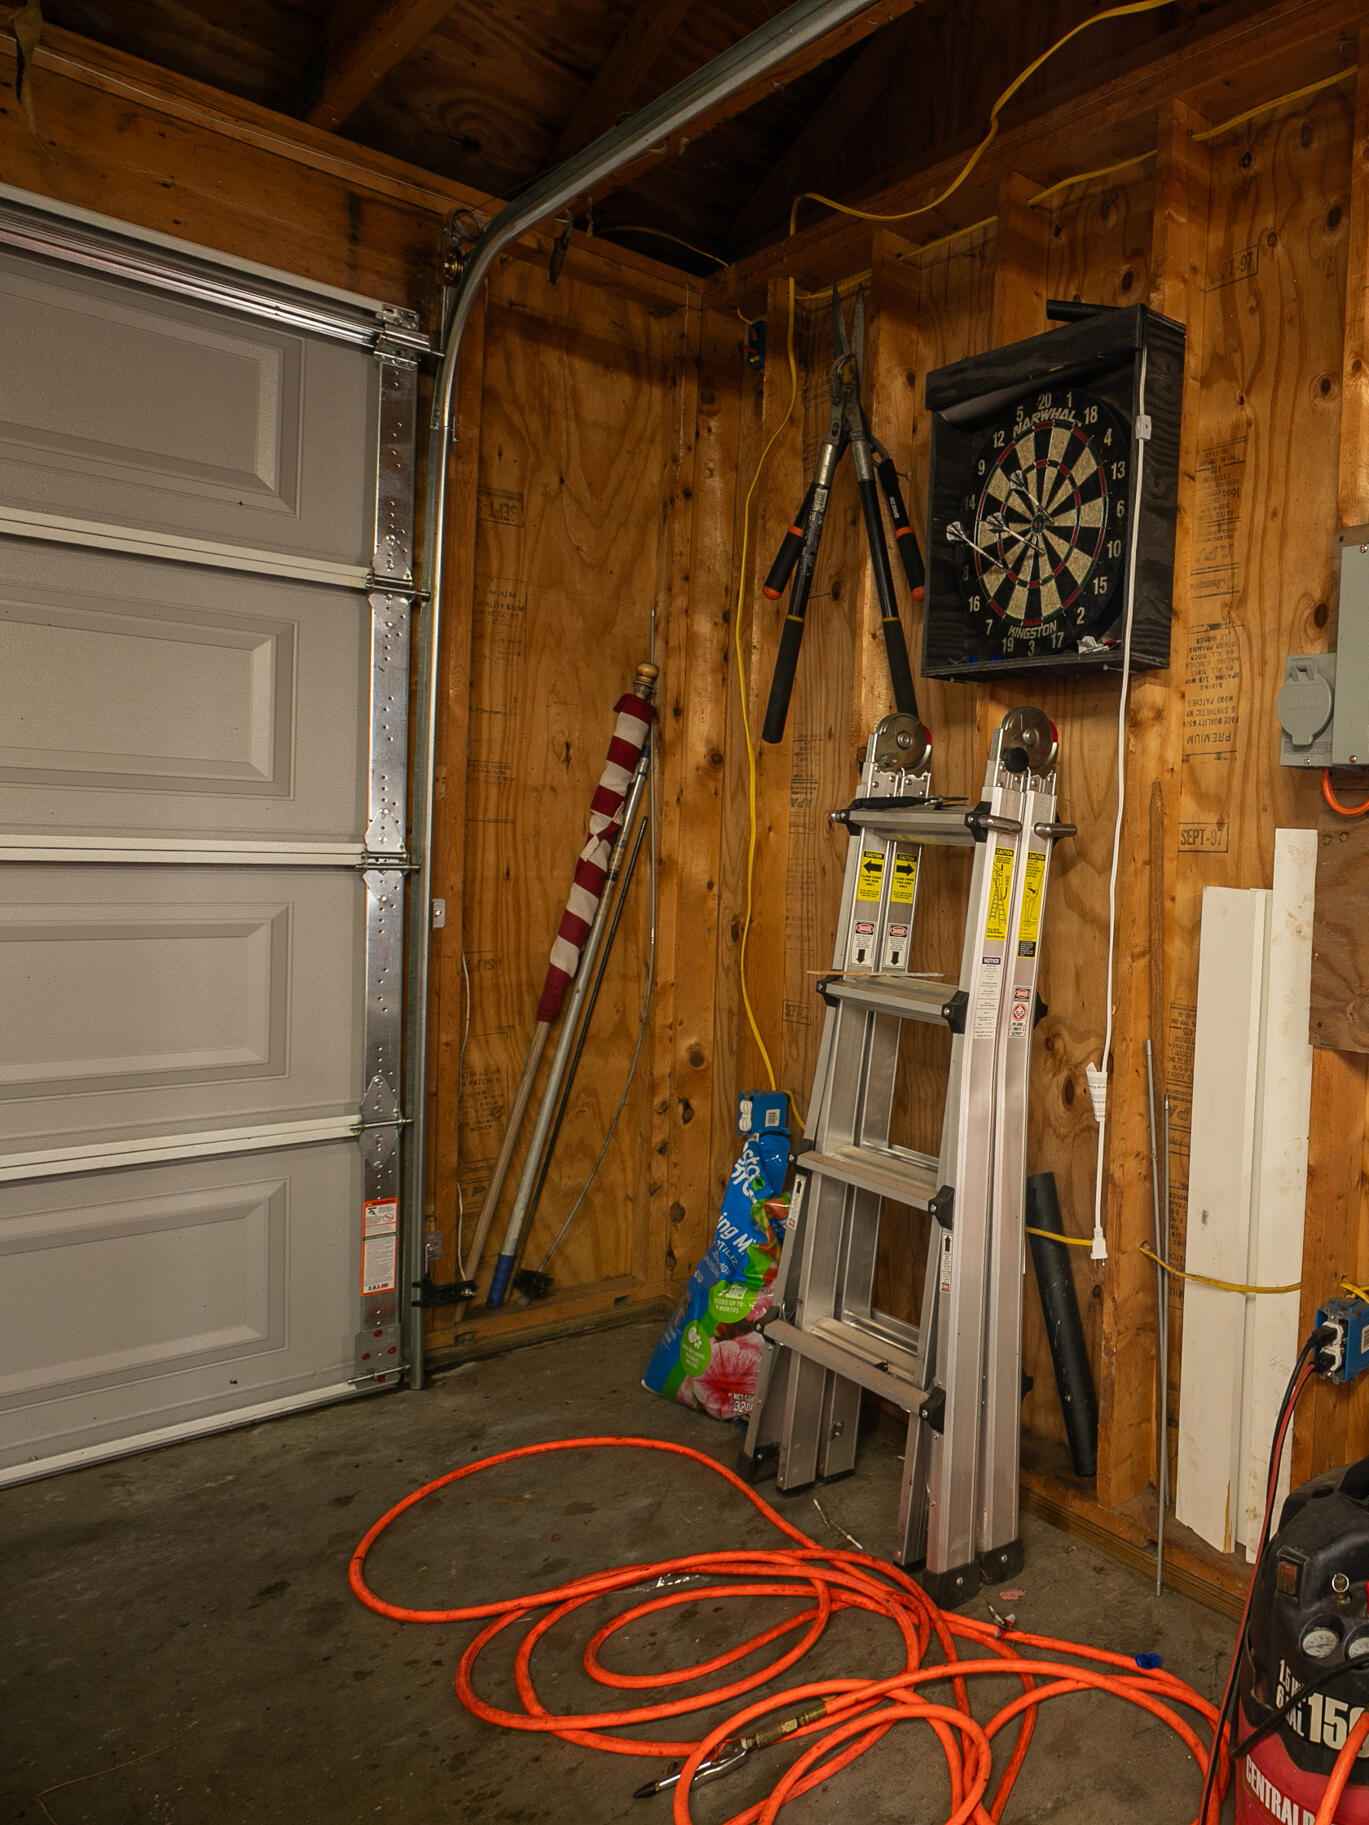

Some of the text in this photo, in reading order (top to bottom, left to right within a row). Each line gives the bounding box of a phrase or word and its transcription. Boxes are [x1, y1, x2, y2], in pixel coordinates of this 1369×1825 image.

[1038, 393, 1051, 409] 20
[1066, 392, 1073, 406] 1
[1016, 406, 1024, 420] 5
[1084, 405, 1098, 424] 18
[1012, 407, 1077, 438] NARWHAL
[993, 431, 1005, 448] 12
[1104, 428, 1112, 445] 4
[978, 459, 985, 476] 9
[1111, 461, 1126, 479] 13
[1116, 500, 1125, 518] 6
[1107, 540, 1122, 558] 10
[1093, 577, 1107, 594] 15
[968, 597, 981, 612] 16
[1076, 607, 1085, 624] 2
[986, 619, 993, 635] 7
[1008, 621, 1056, 639] KINGSTON
[1002, 636, 1014, 652] 19
[1028, 641, 1035, 656] 3
[1052, 632, 1064, 648] 17
[1186, 731, 1231, 744] PREMIUM
